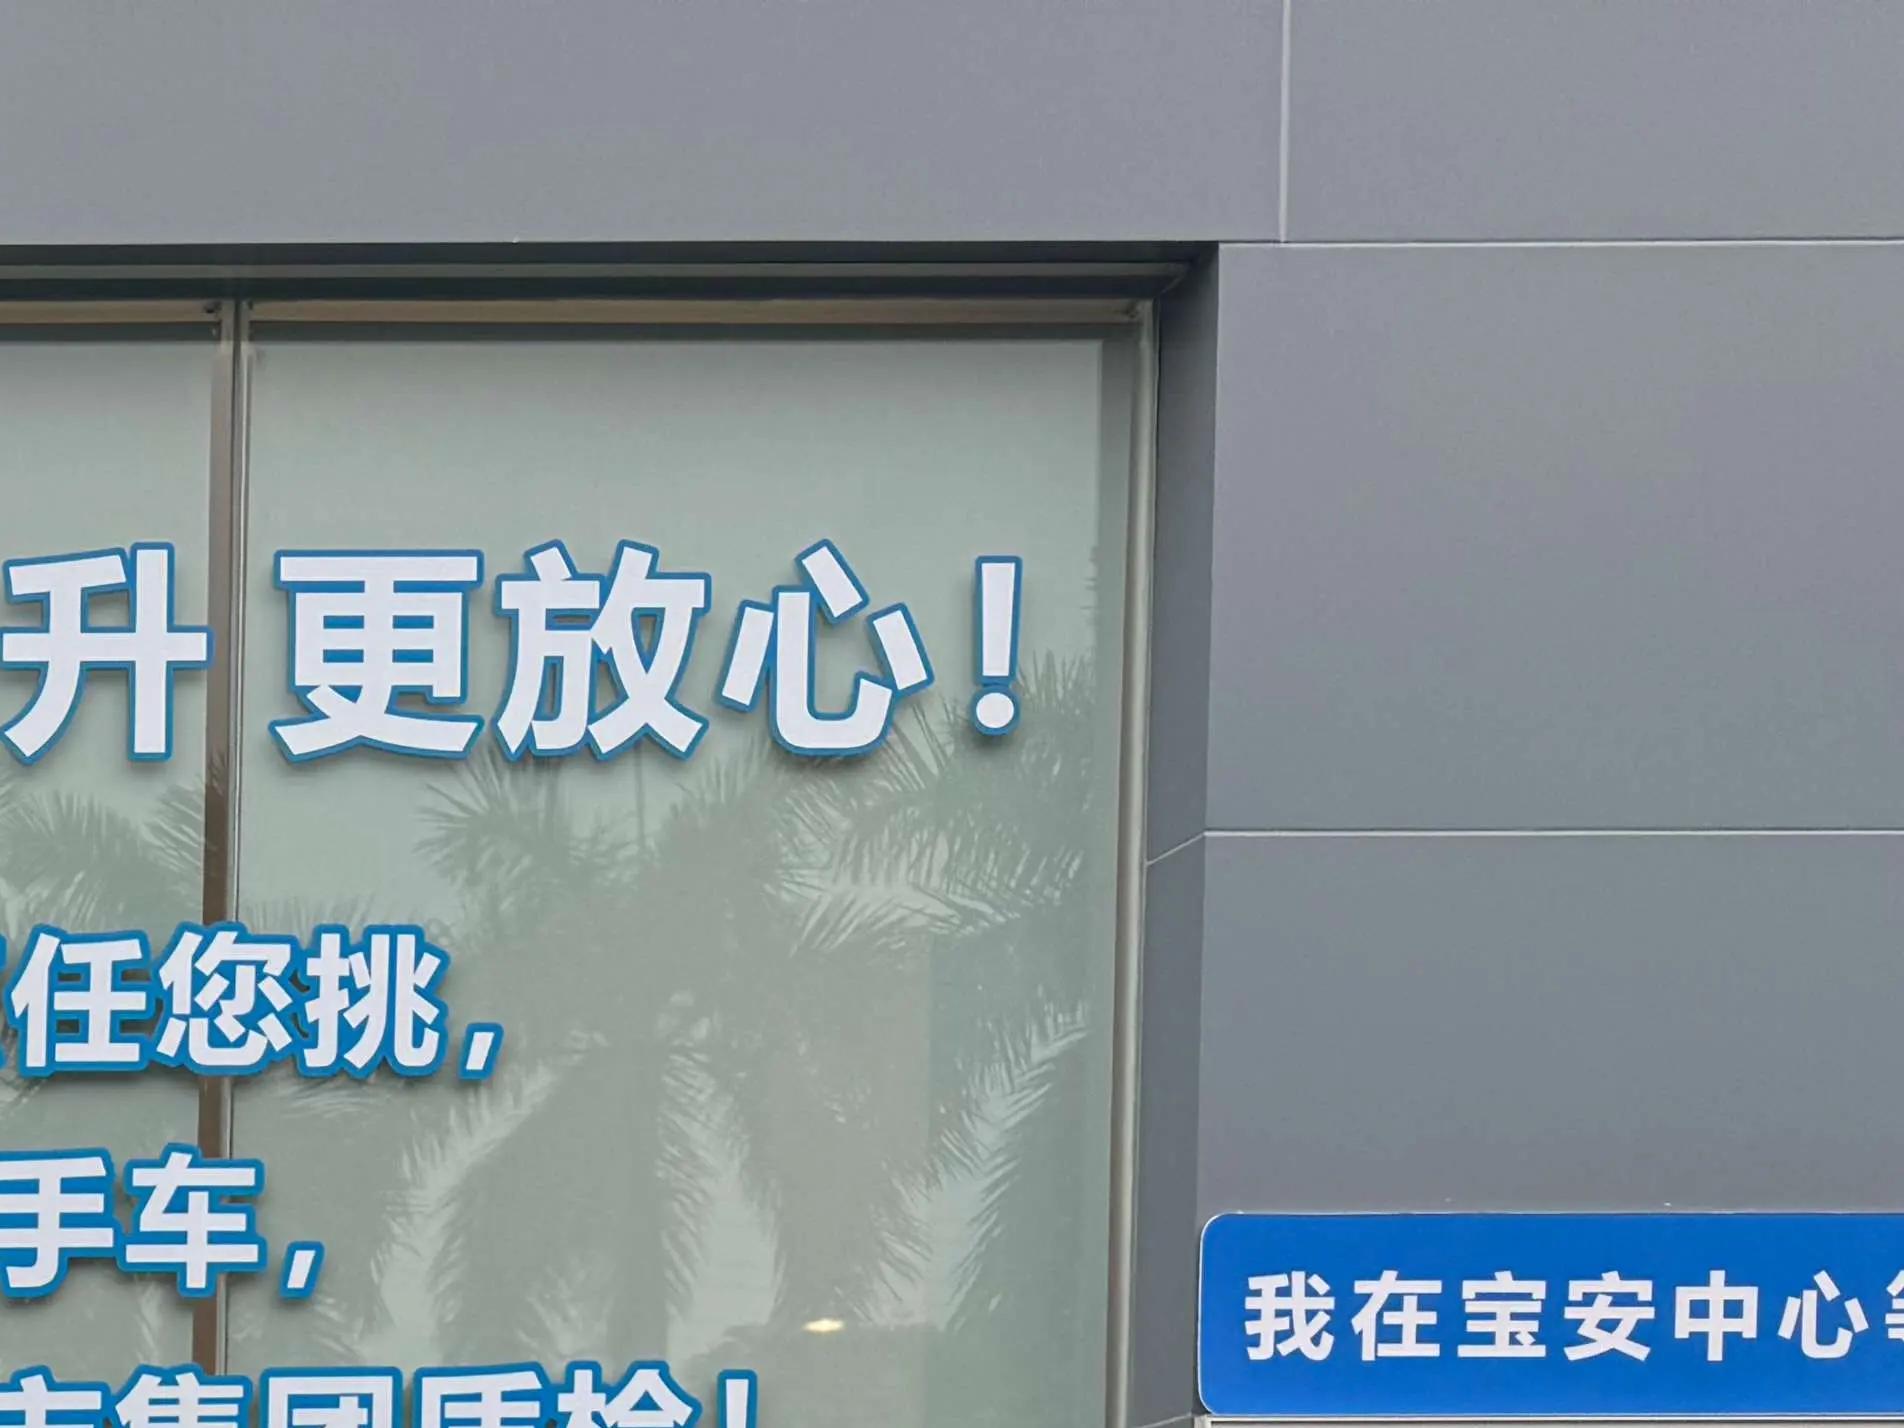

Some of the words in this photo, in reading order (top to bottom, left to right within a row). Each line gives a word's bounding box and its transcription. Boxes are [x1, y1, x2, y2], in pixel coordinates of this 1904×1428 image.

[269, 541, 1022, 762] 更放心！
[1244, 1270, 1904, 1362] 我在宝安中心
